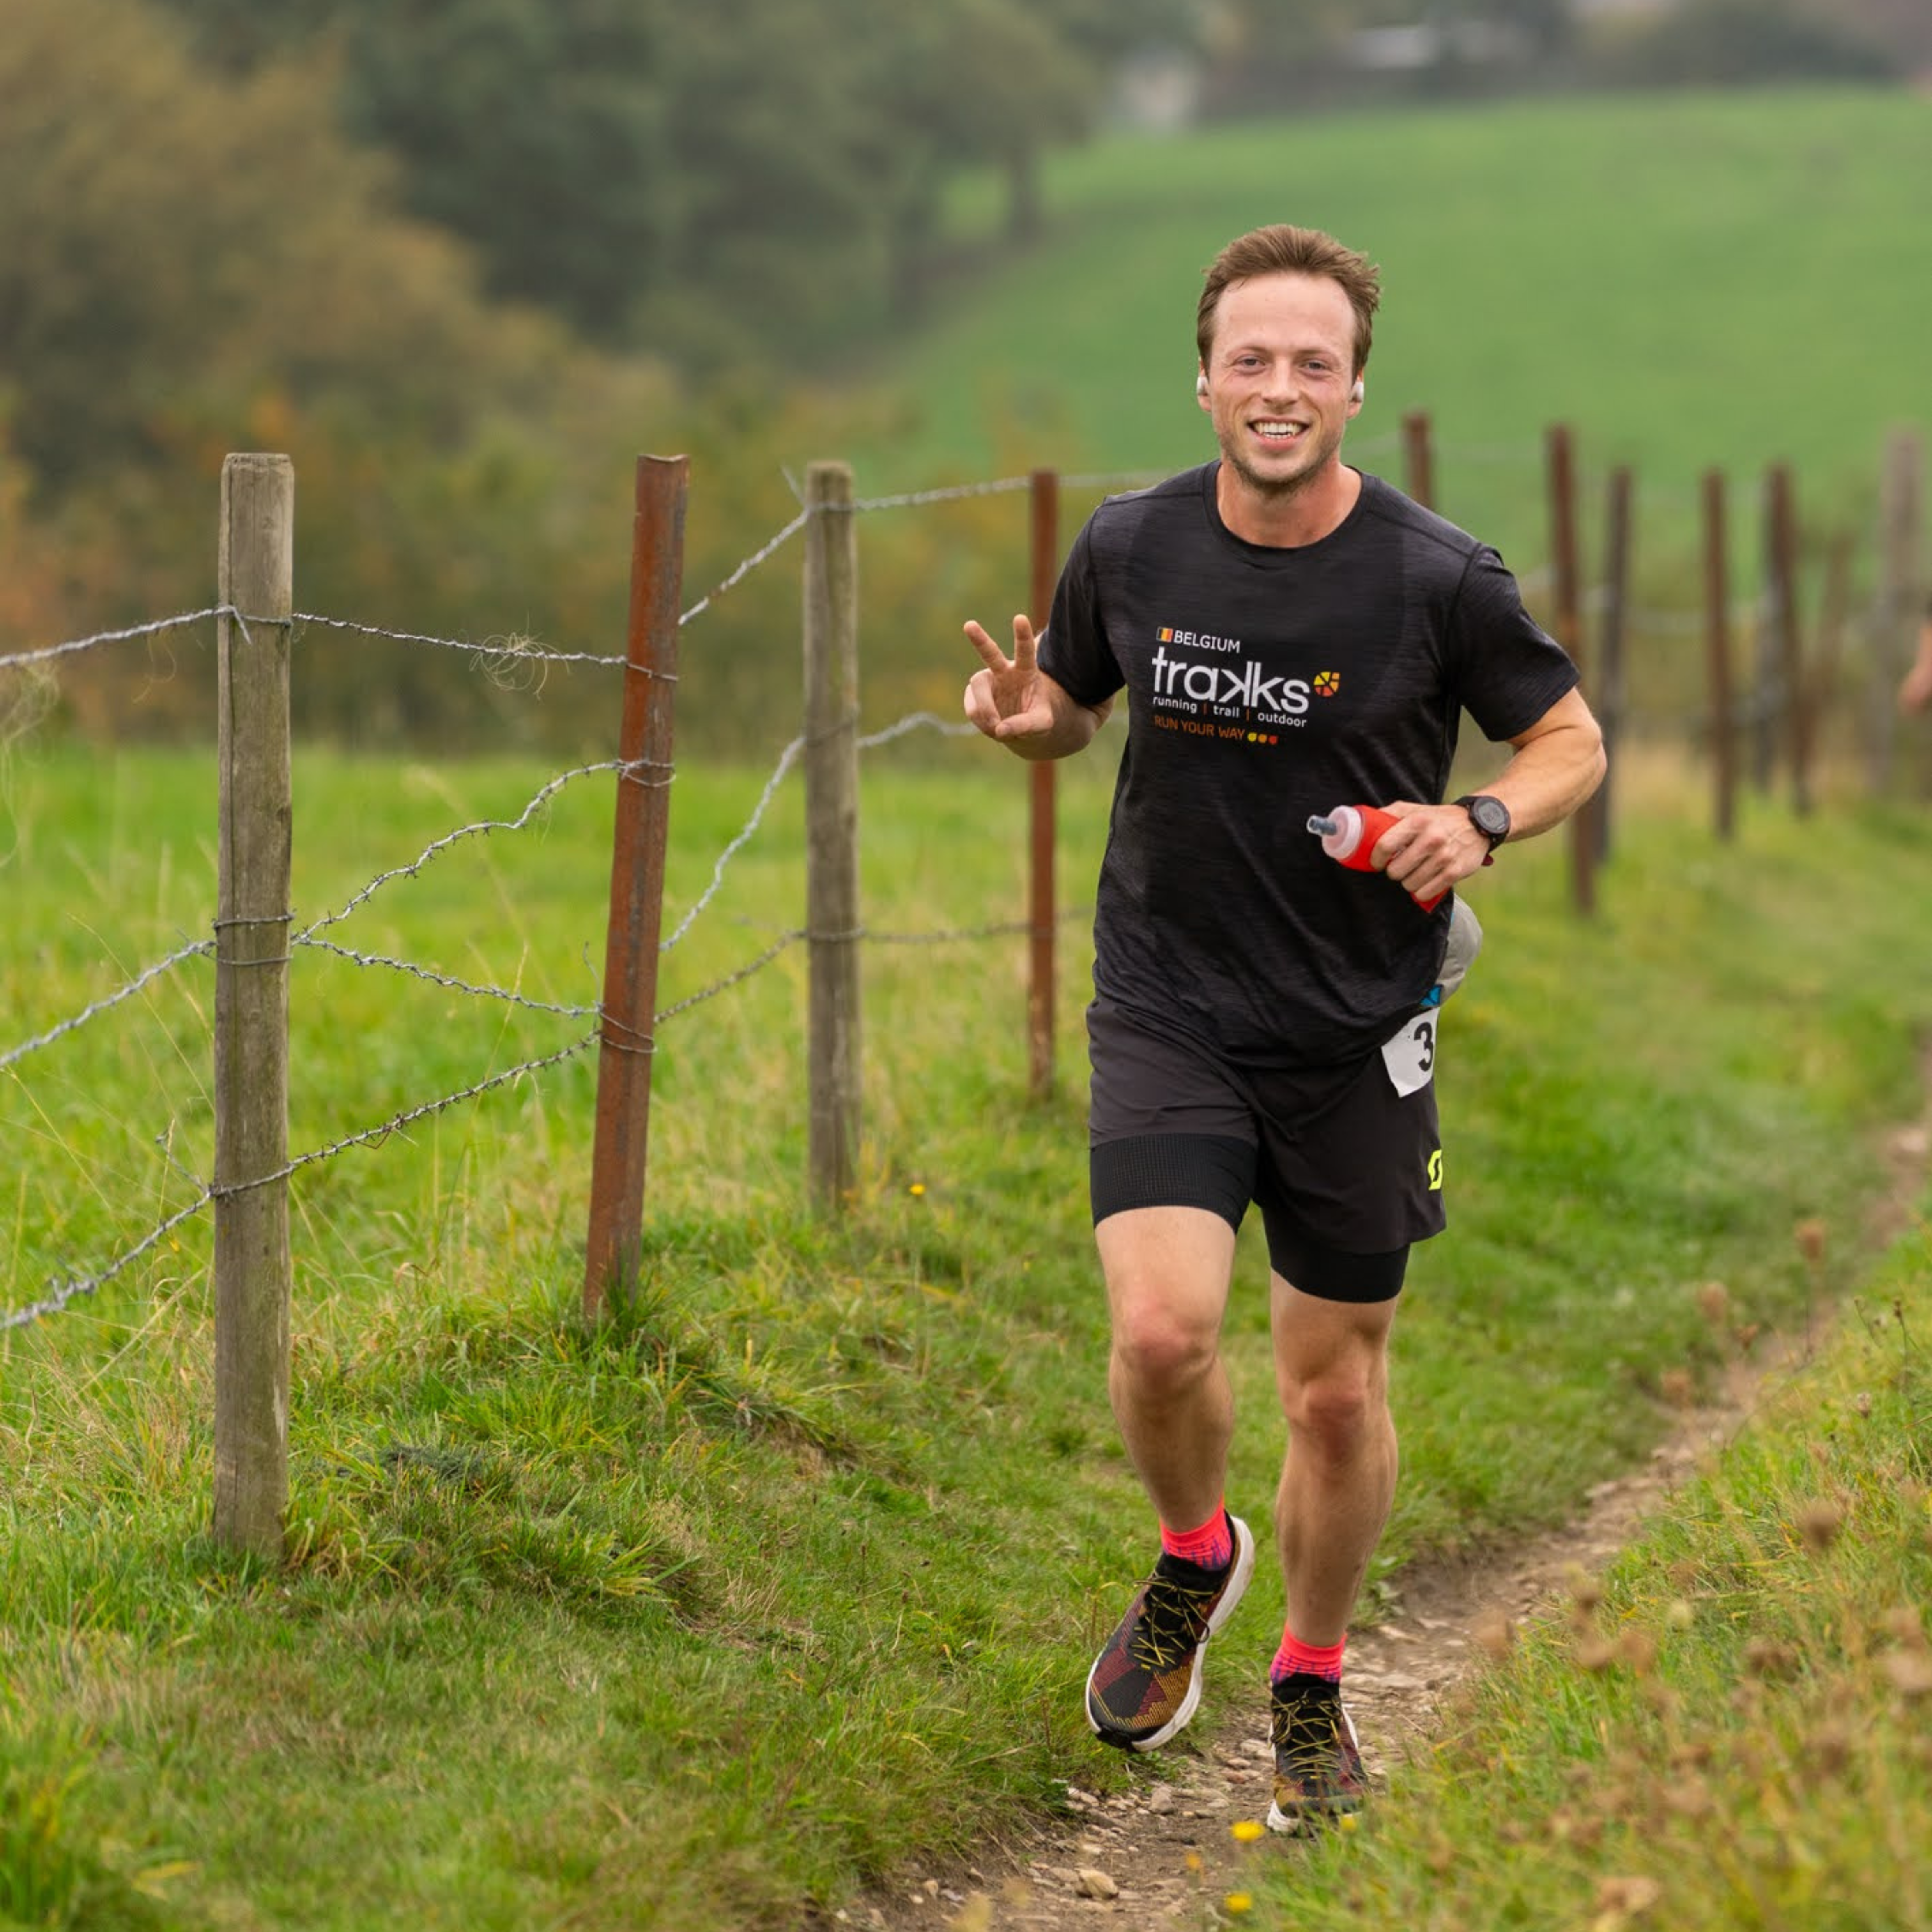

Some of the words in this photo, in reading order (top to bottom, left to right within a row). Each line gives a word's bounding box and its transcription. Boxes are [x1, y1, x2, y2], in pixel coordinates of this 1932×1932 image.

[1173, 630, 1240, 653] BELGIUM
[1152, 646, 1311, 713] trakks
[1153, 696, 1198, 713] running
[1213, 705, 1240, 718] trail
[1258, 711, 1307, 727] outdoor
[1154, 715, 1178, 730] RUN
[1181, 721, 1214, 736] YOUR
[1218, 727, 1245, 740] WAY
[1414, 1022, 1434, 1072] 3
